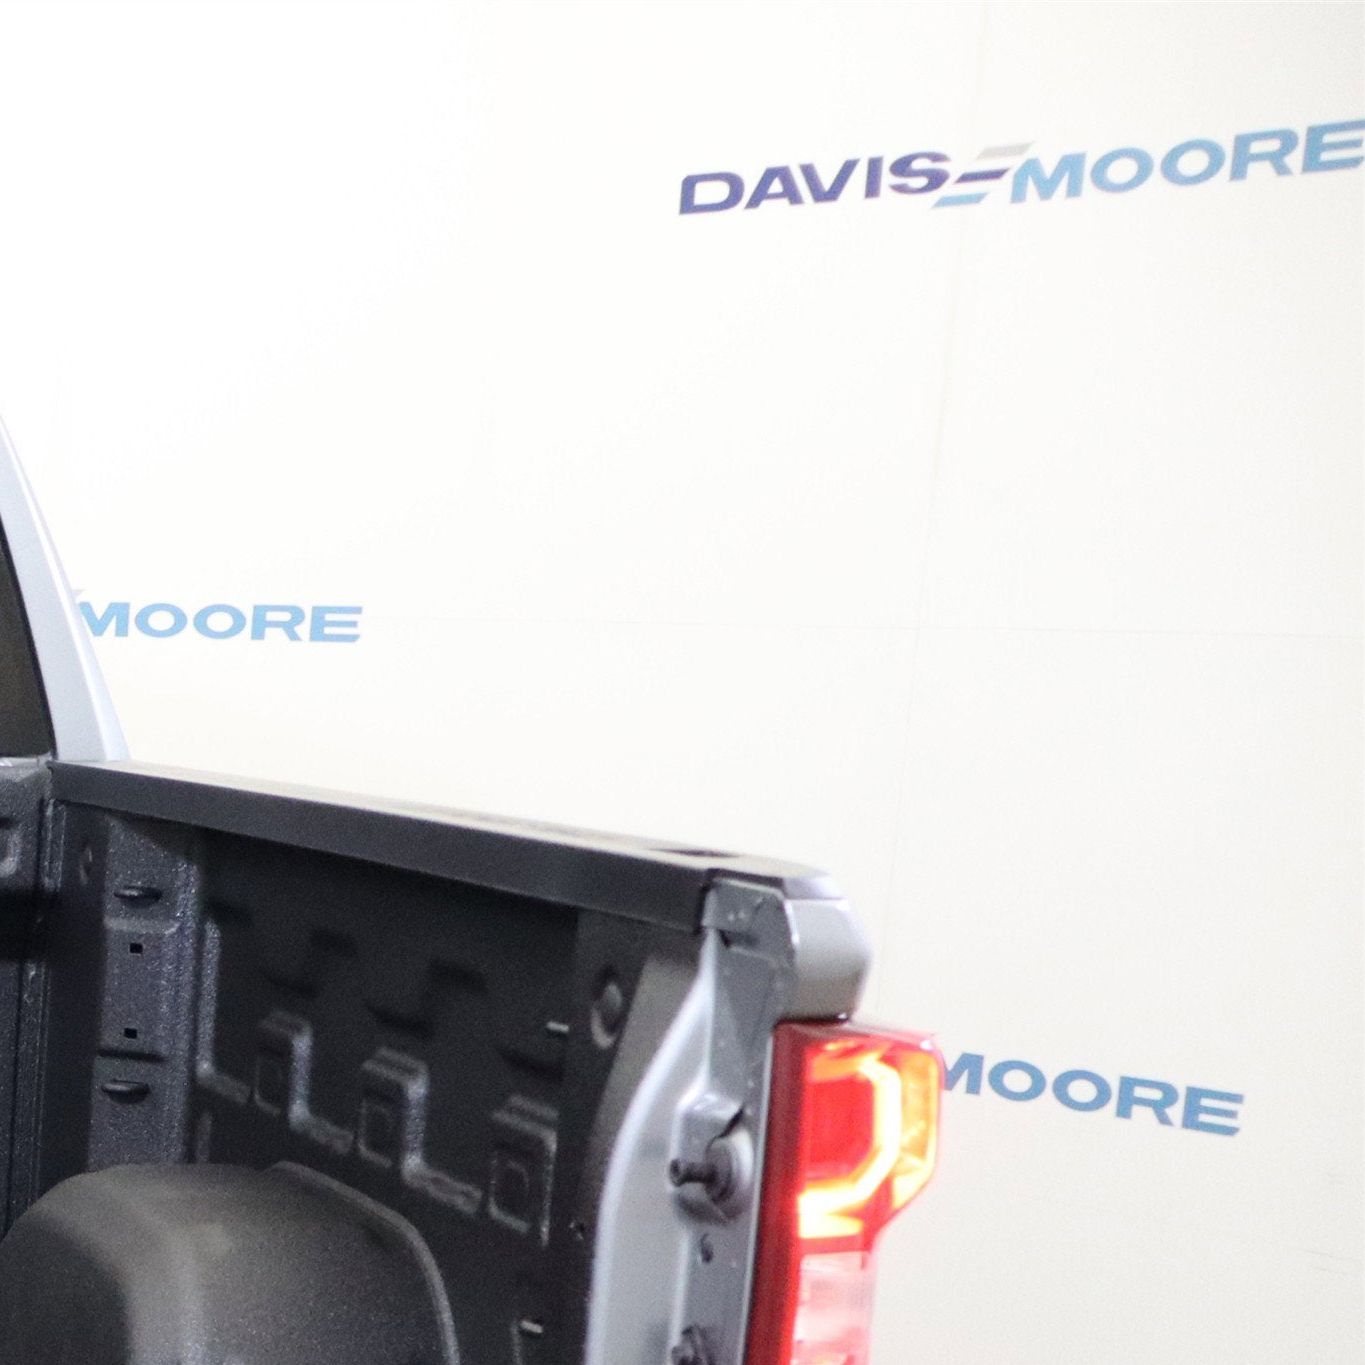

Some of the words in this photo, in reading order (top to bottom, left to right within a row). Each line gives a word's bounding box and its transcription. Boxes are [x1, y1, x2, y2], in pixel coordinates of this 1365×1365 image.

[678, 150, 952, 215] DAVIS
[1009, 118, 1365, 204] MOORE
[77, 601, 362, 643] MOORE
